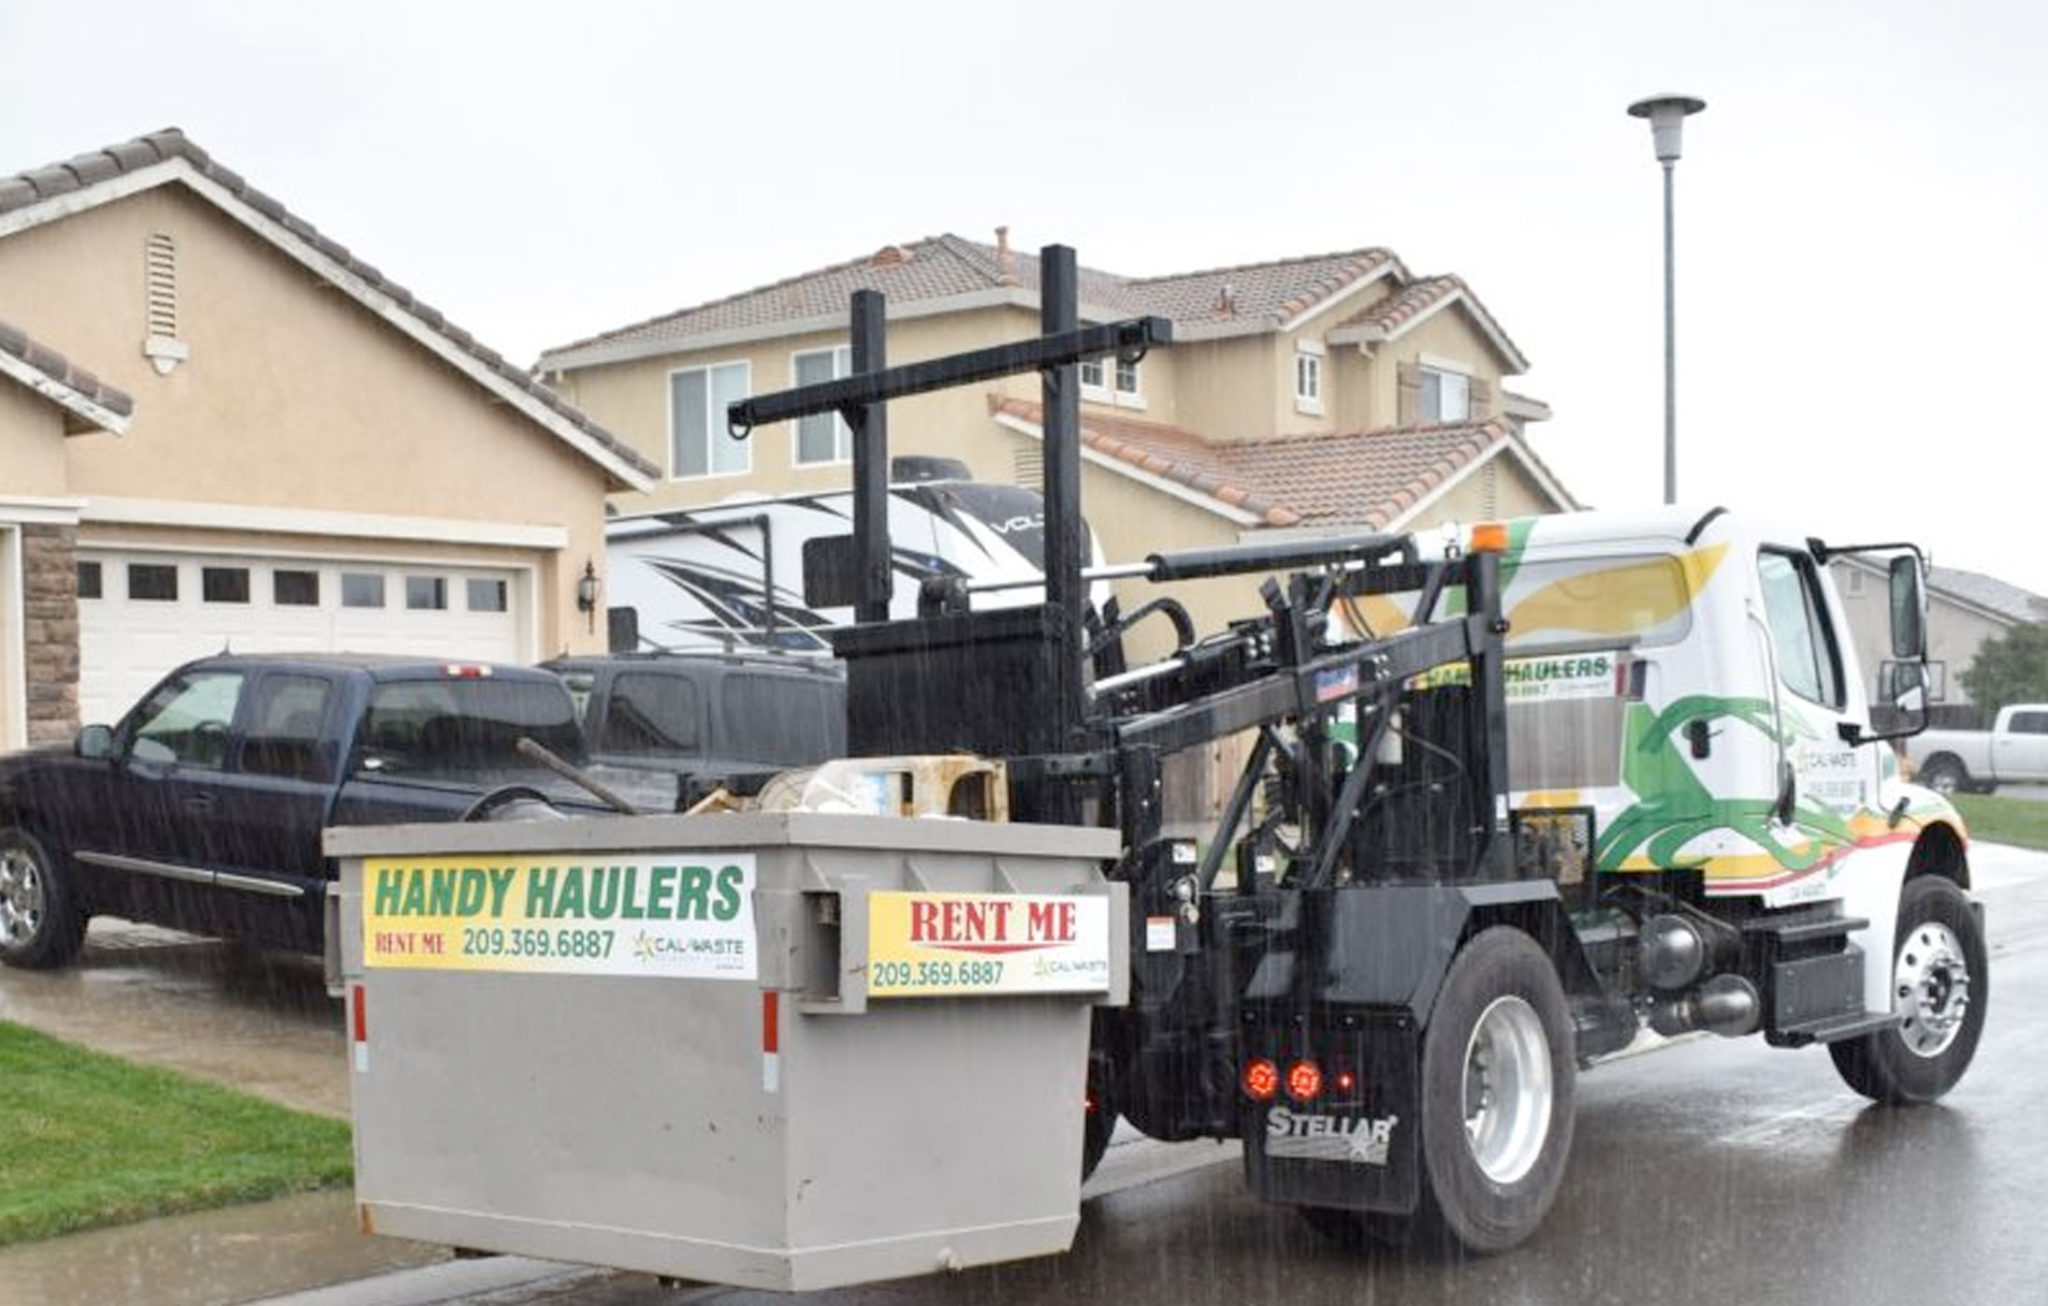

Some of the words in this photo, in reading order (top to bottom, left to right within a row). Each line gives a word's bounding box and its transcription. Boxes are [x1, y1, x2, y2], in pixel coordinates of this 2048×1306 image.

[990, 513, 1045, 533] VOL
[1505, 657, 1611, 682] HAULERS
[374, 867, 515, 918] HANDY
[525, 864, 744, 922] HAULERS
[910, 900, 1012, 942] RENT
[1028, 901, 1076, 942] ME
[375, 932, 417, 954] RENT
[420, 932, 445, 955] ME
[462, 927, 616, 960] 209.369.6887
[873, 960, 1005, 987] 209.369.6887
[1266, 1105, 1391, 1144] STELLAR
